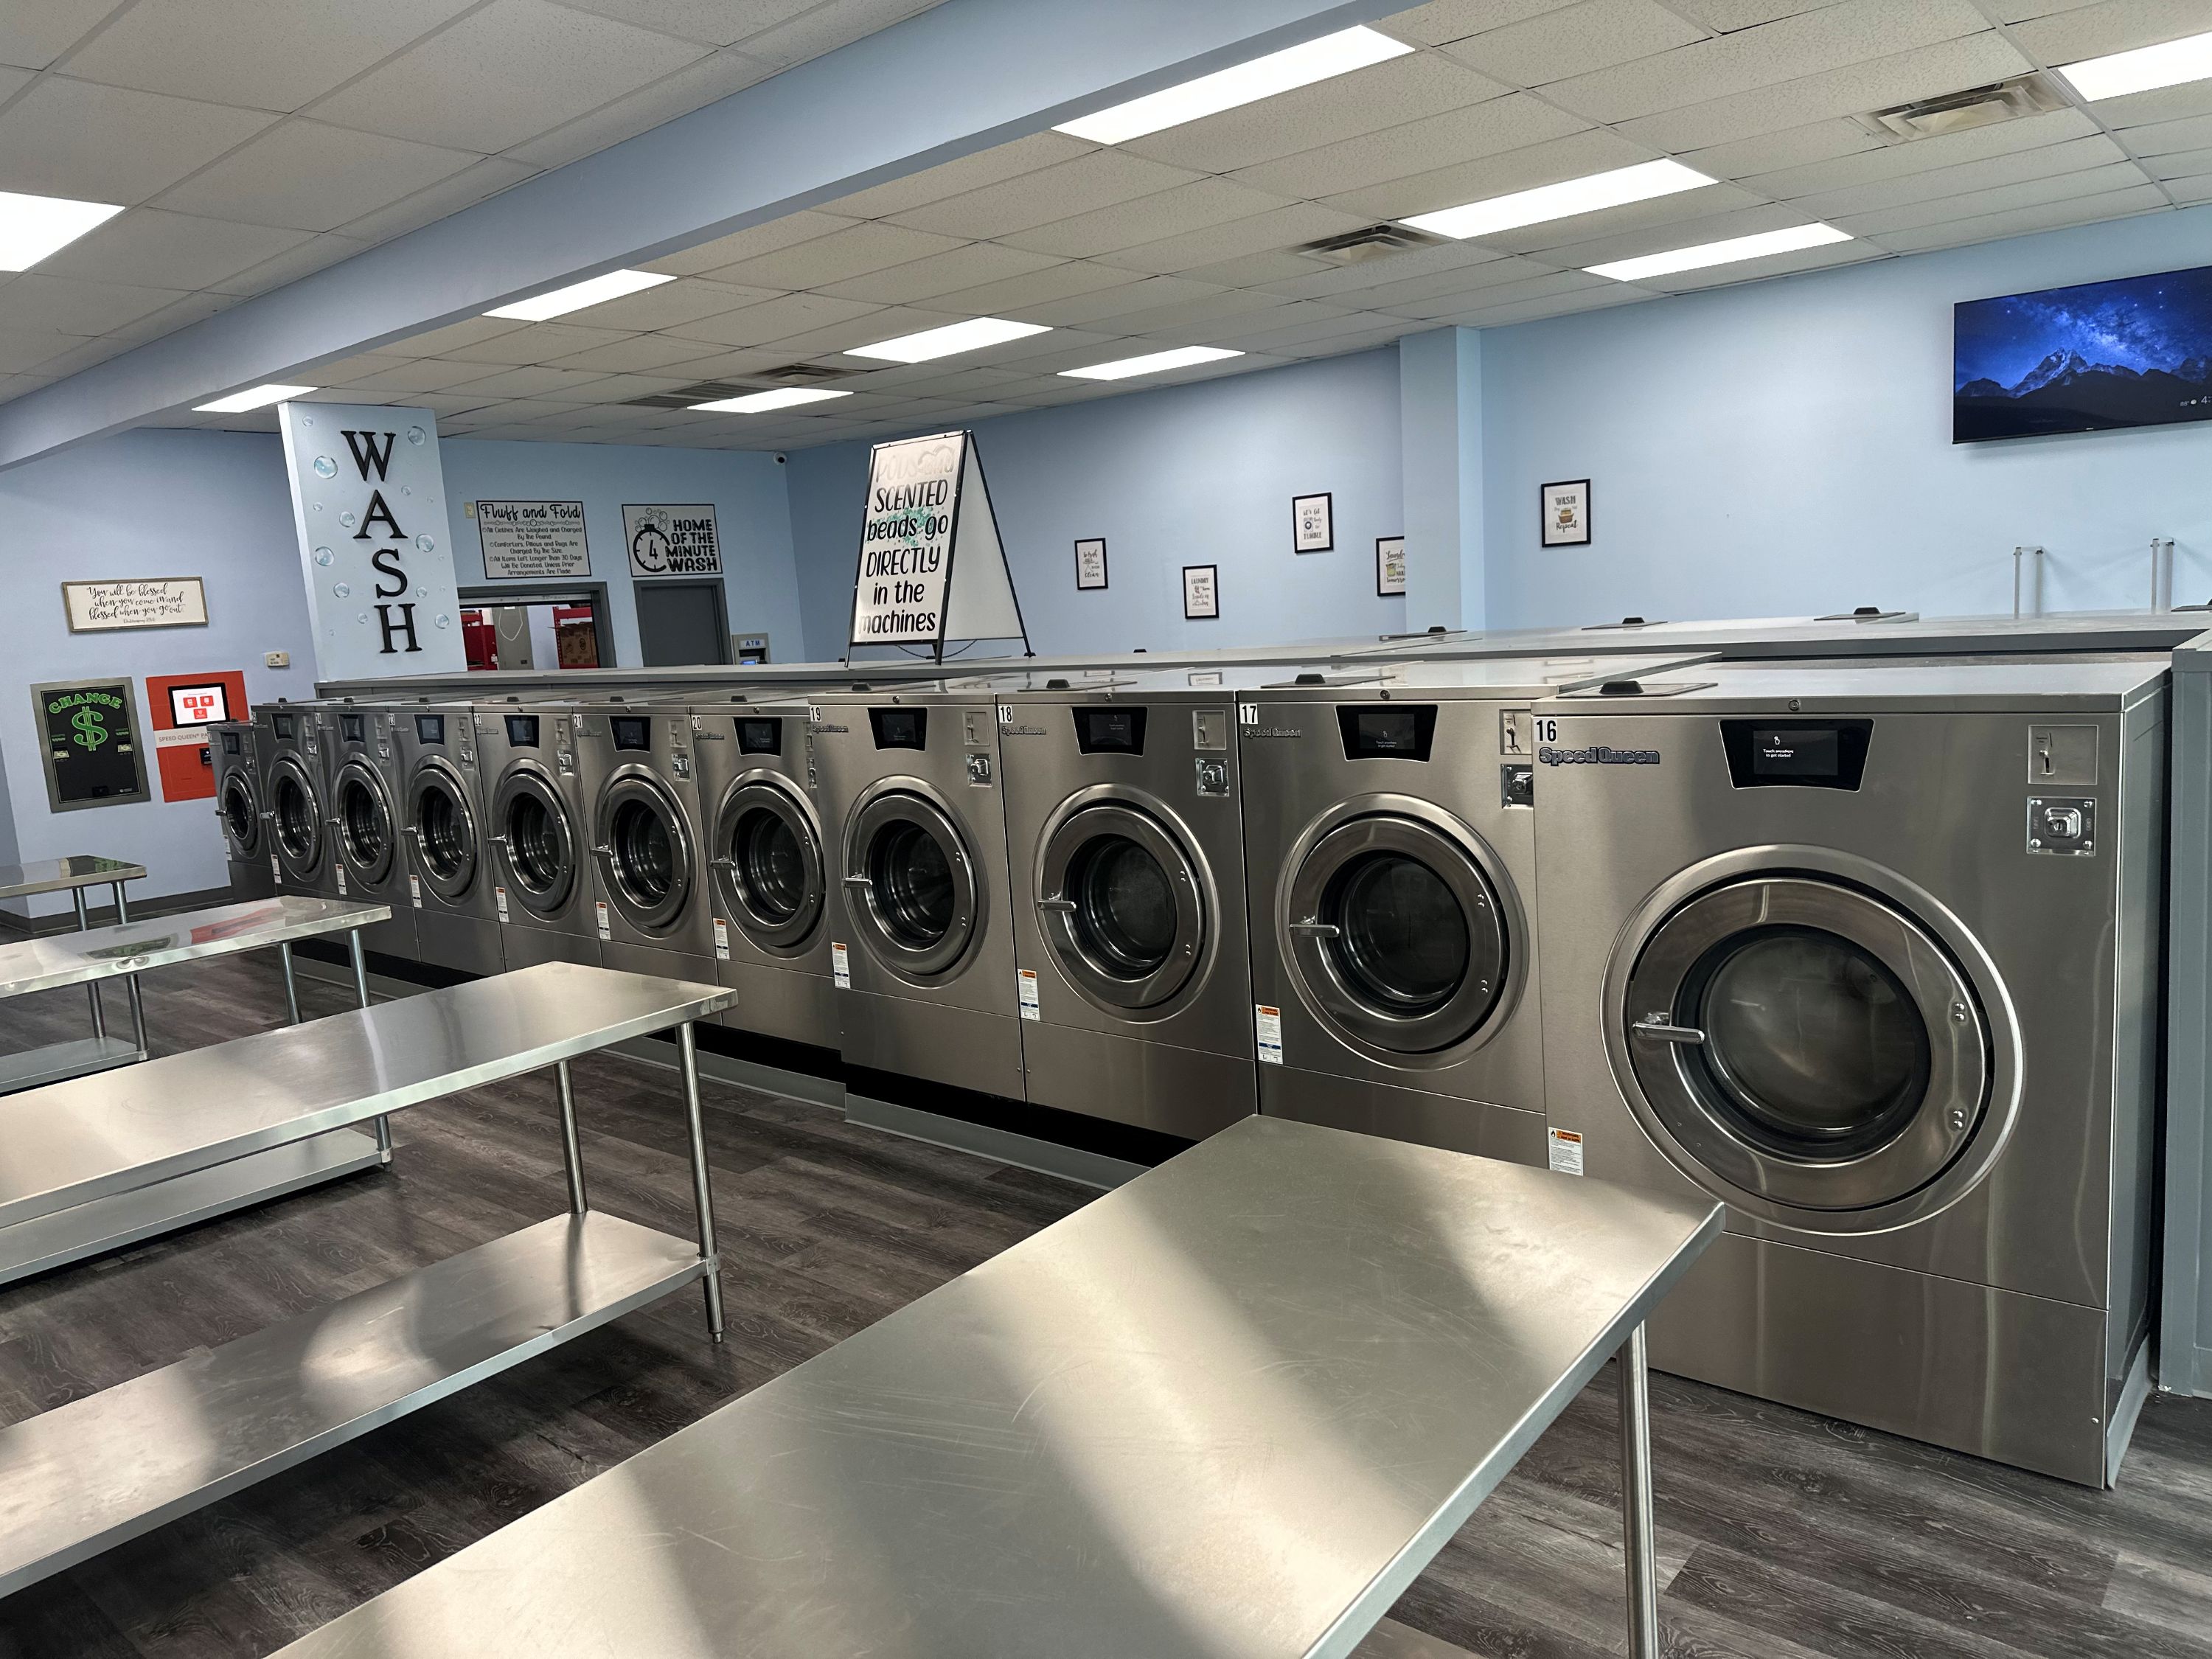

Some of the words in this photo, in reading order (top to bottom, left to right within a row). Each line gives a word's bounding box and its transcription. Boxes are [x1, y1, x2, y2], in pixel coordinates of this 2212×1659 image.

[2201, 396, 2212, 404] 4:
[874, 479, 948, 513] SCENTED
[1555, 495, 1576, 506] WASH
[480, 504, 518, 521] Fluff
[523, 505, 547, 518] and
[549, 504, 581, 518] Fold
[672, 519, 712, 532] HOME
[867, 515, 918, 542] beads
[925, 515, 948, 540] go
[1556, 520, 1577, 533] Repeat
[341, 431, 422, 653] WASH
[670, 532, 687, 545] OF
[689, 532, 714, 544] THE
[649, 540, 658, 560] 4
[665, 545, 715, 557] MINUTE
[667, 557, 717, 572] WASH
[866, 546, 941, 577] DIRECTLY
[87, 586, 109, 599] You
[110, 585, 124, 597] will
[126, 585, 136, 596] be
[138, 582, 169, 597] blessed
[874, 582, 888, 605] in
[894, 580, 925, 605] the
[94, 596, 118, 608] when
[119, 599, 134, 608] you
[166, 591, 184, 603] and
[88, 606, 119, 620] blessed
[119, 605, 142, 616] when
[142, 607, 158, 616] you
[159, 605, 169, 615] go
[858, 609, 936, 634] machines
[49, 692, 122, 714] CHANGE
[574, 715, 582, 728] 21
[811, 706, 821, 721] 19
[1001, 706, 1012, 722] 18
[1242, 705, 1256, 723] 17
[692, 717, 702, 729] 20
[1537, 720, 1557, 742] 16
[1539, 747, 1597, 767] Speed
[1597, 747, 1660, 765] Queen
